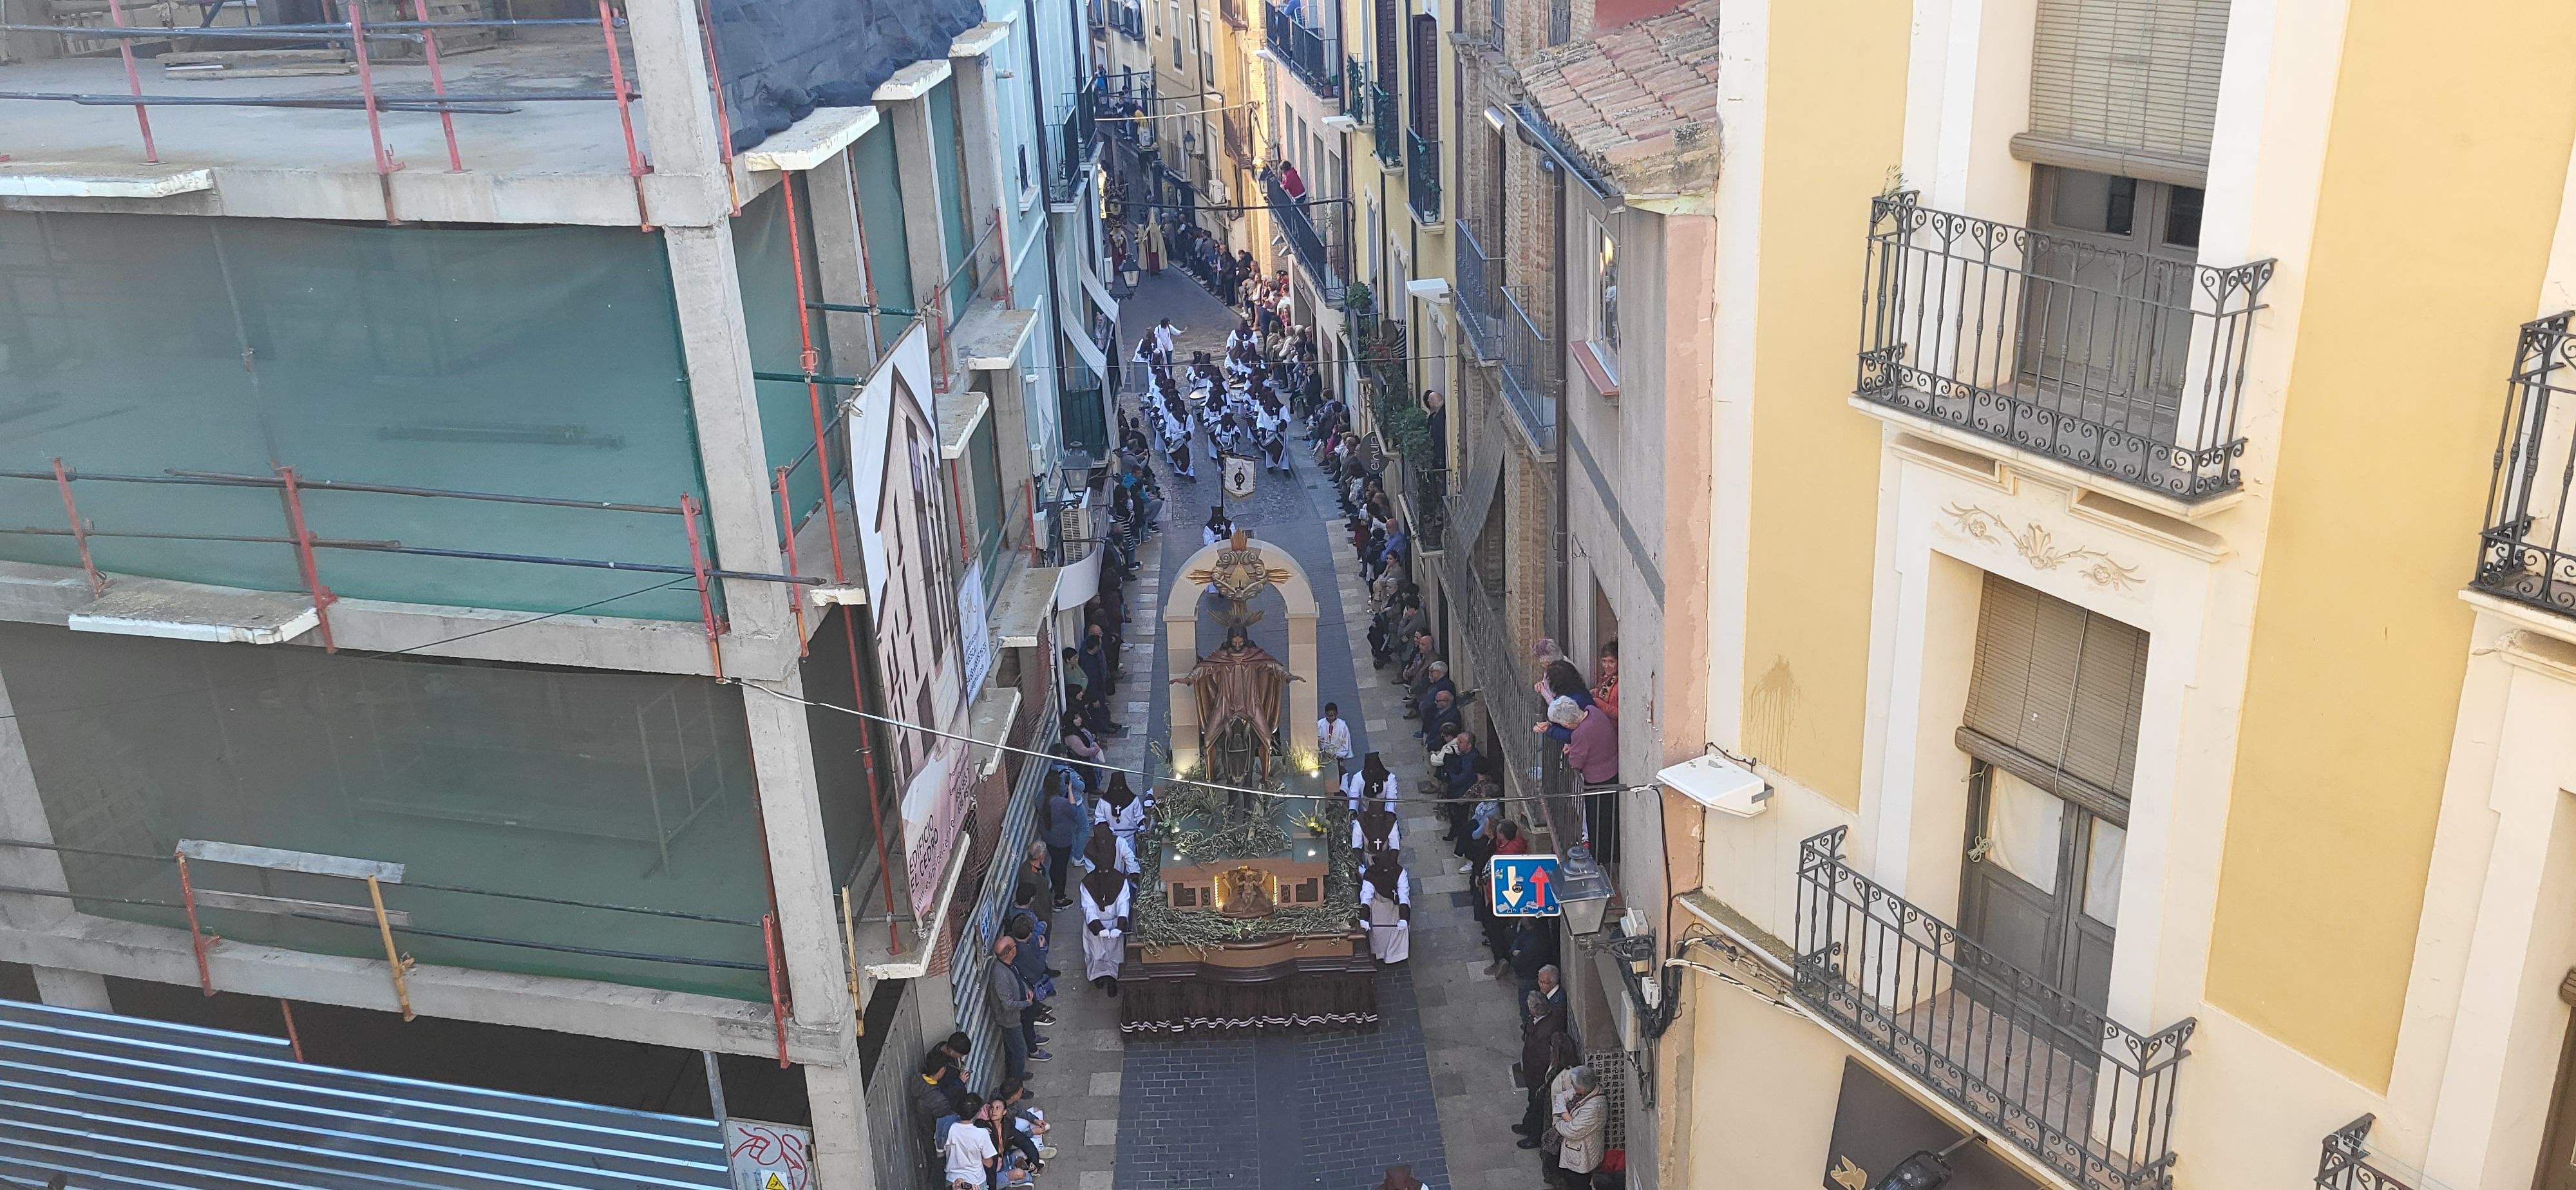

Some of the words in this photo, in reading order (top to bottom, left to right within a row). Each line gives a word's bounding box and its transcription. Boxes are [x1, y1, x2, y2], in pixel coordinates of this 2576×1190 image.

[909, 814, 934, 876] EDIFICIO
[911, 873, 920, 895] EL
[920, 827, 939, 877] CEDRO
